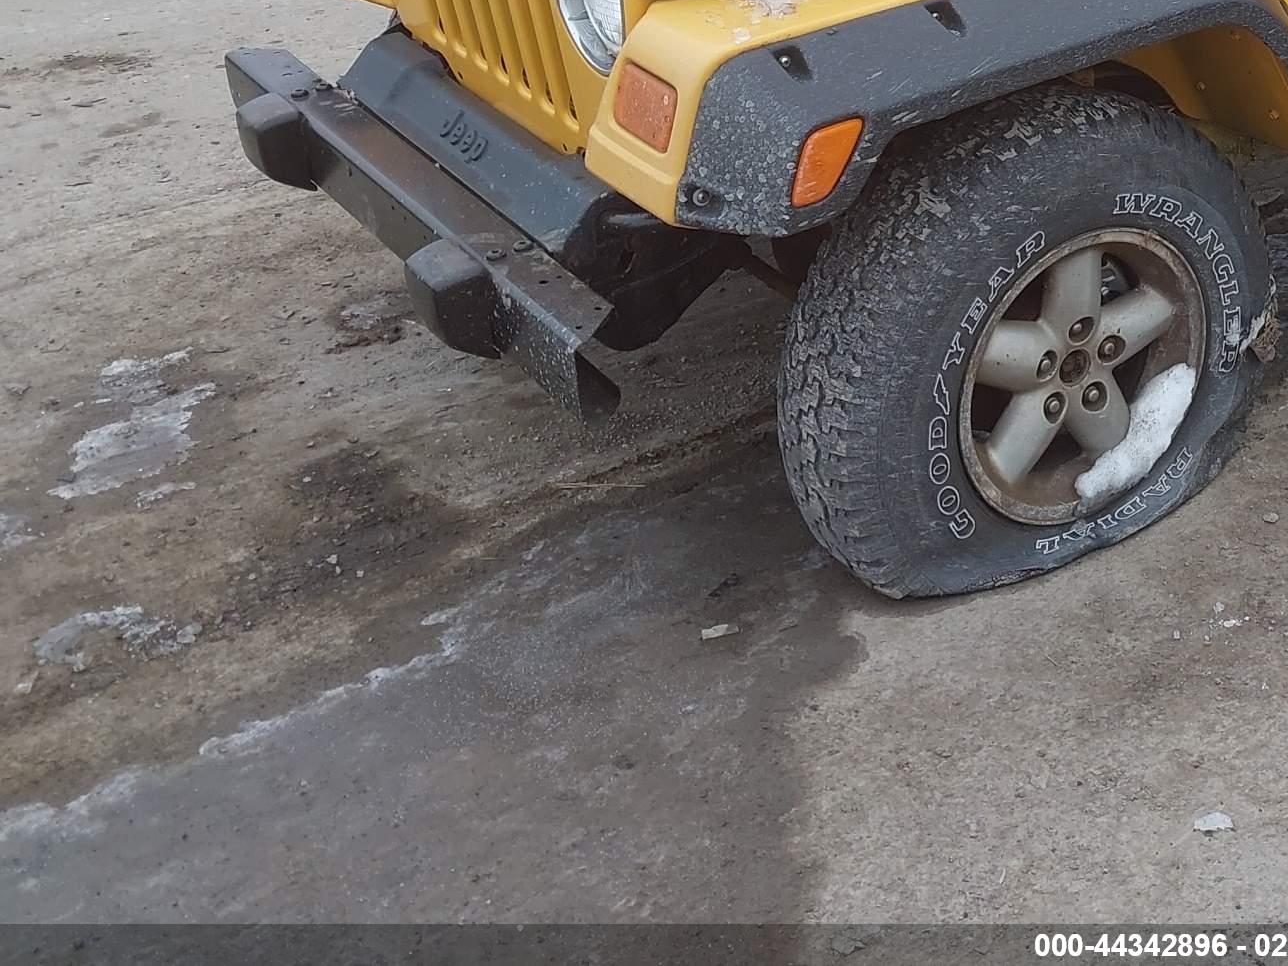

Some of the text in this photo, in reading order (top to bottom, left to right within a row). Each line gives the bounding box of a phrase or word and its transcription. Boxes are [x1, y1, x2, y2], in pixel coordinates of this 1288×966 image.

[439, 109, 489, 164] Jeep
[1113, 192, 1244, 375] WRANGLER
[1035, 446, 1194, 555] RADIAL
